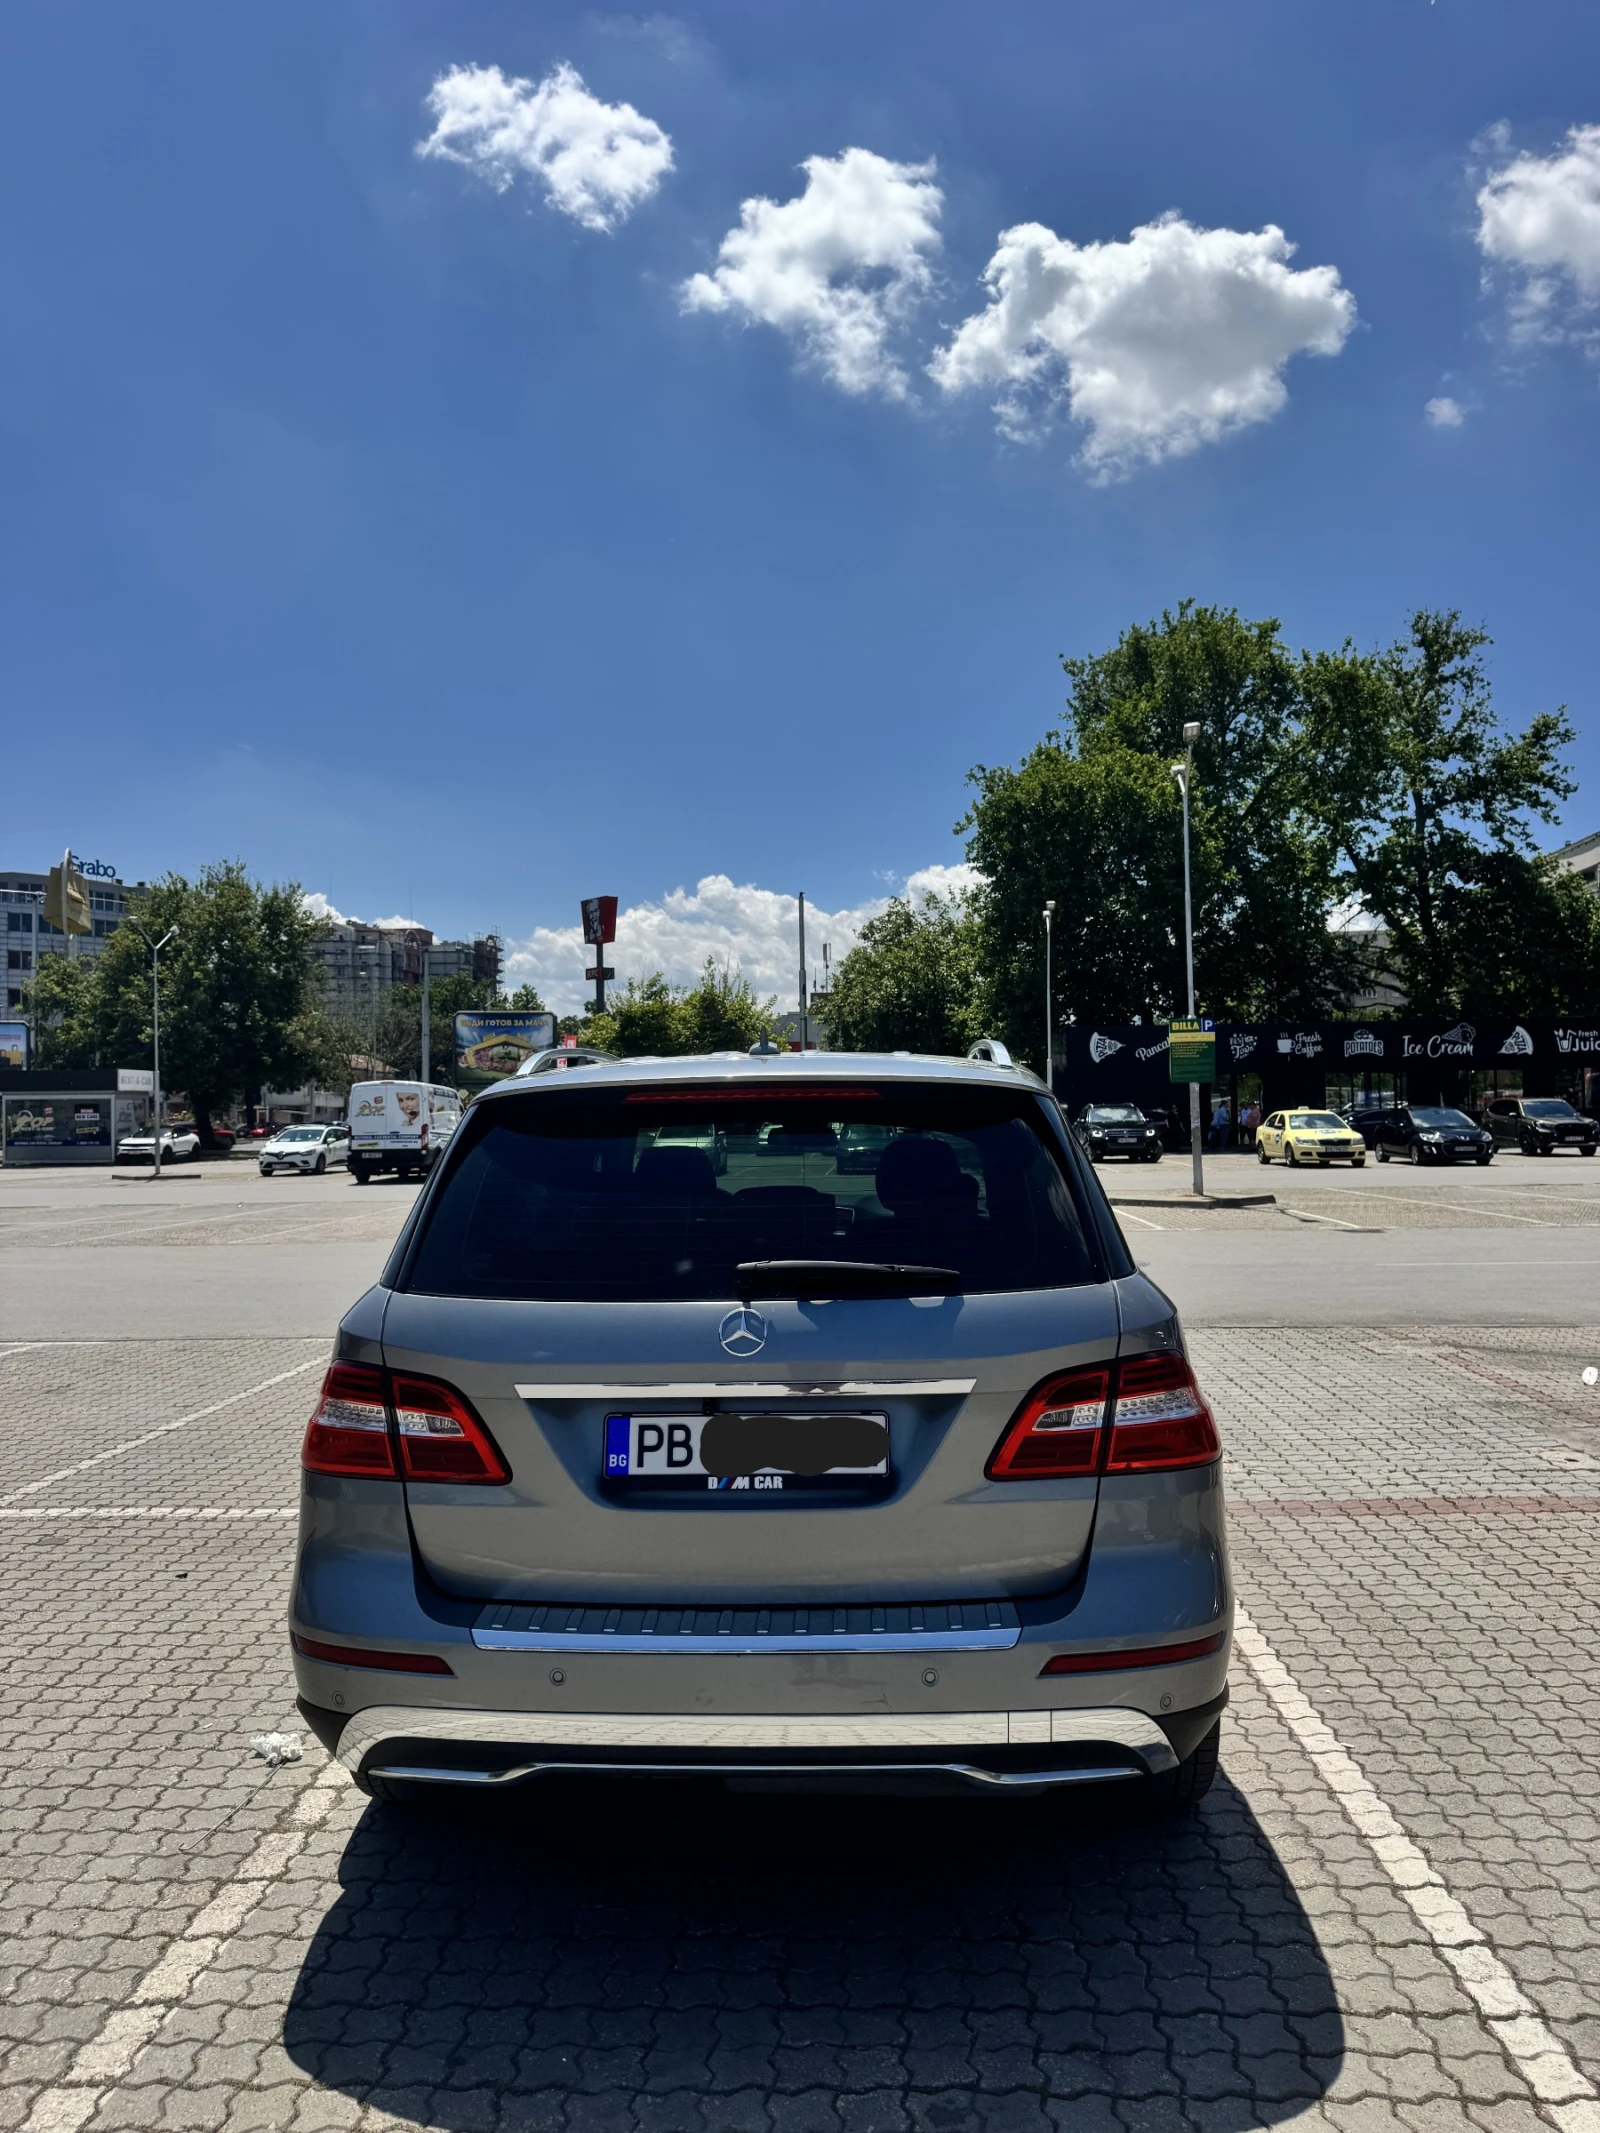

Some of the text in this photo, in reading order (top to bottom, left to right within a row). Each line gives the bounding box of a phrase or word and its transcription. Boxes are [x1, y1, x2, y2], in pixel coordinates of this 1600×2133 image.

[71, 855, 116, 878] Grabo
[485, 1019, 512, 1027] ГОТОВ
[514, 1019, 524, 1027] ЗА
[1171, 1021, 1200, 1031] BILLA
[1204, 1020, 1213, 1031] P
[1295, 1031, 1322, 1043] Fresh
[1295, 1043, 1324, 1058] Coffee
[1344, 1039, 1384, 1057] POTATOES
[1402, 1035, 1474, 1058] Ice Cream
[636, 1424, 694, 1468] PB
[609, 1455, 627, 1467] BG
[754, 1476, 783, 1490] CAR
